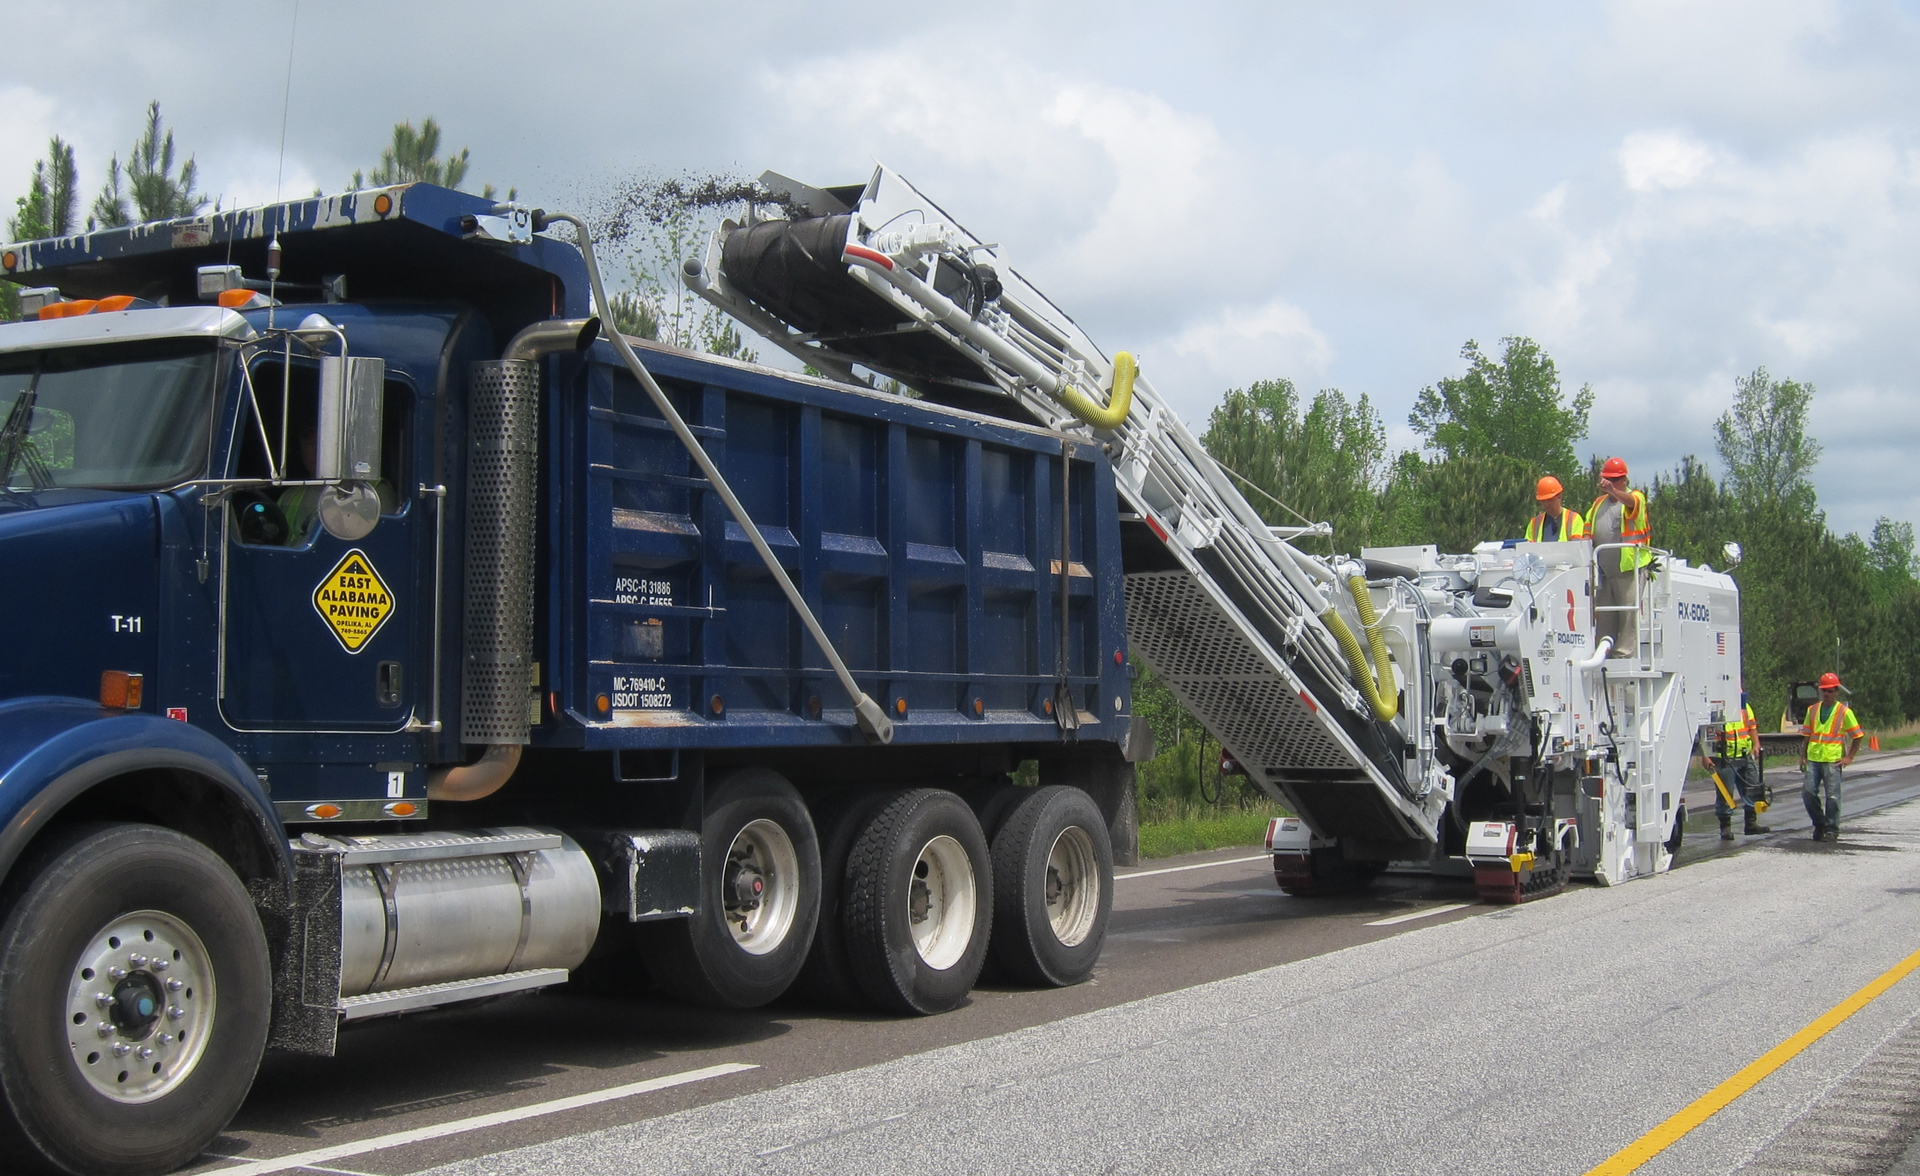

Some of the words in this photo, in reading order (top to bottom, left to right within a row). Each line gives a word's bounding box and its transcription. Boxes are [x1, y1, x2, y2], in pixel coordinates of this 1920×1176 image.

[339, 576, 371, 589] EAST
[615, 577, 647, 593] APSC-R
[648, 580, 671, 595] 31886
[321, 589, 387, 605] ALABAMA
[329, 604, 380, 619] PAVING
[1678, 602, 1709, 622] RX-600e
[111, 615, 142, 633] T-11
[336, 620, 364, 628] OPELIKA,
[1557, 633, 1586, 645] ROADTEC
[611, 692, 639, 707] USDOT
[640, 693, 672, 707] 1508272
[392, 775, 399, 794] 1
